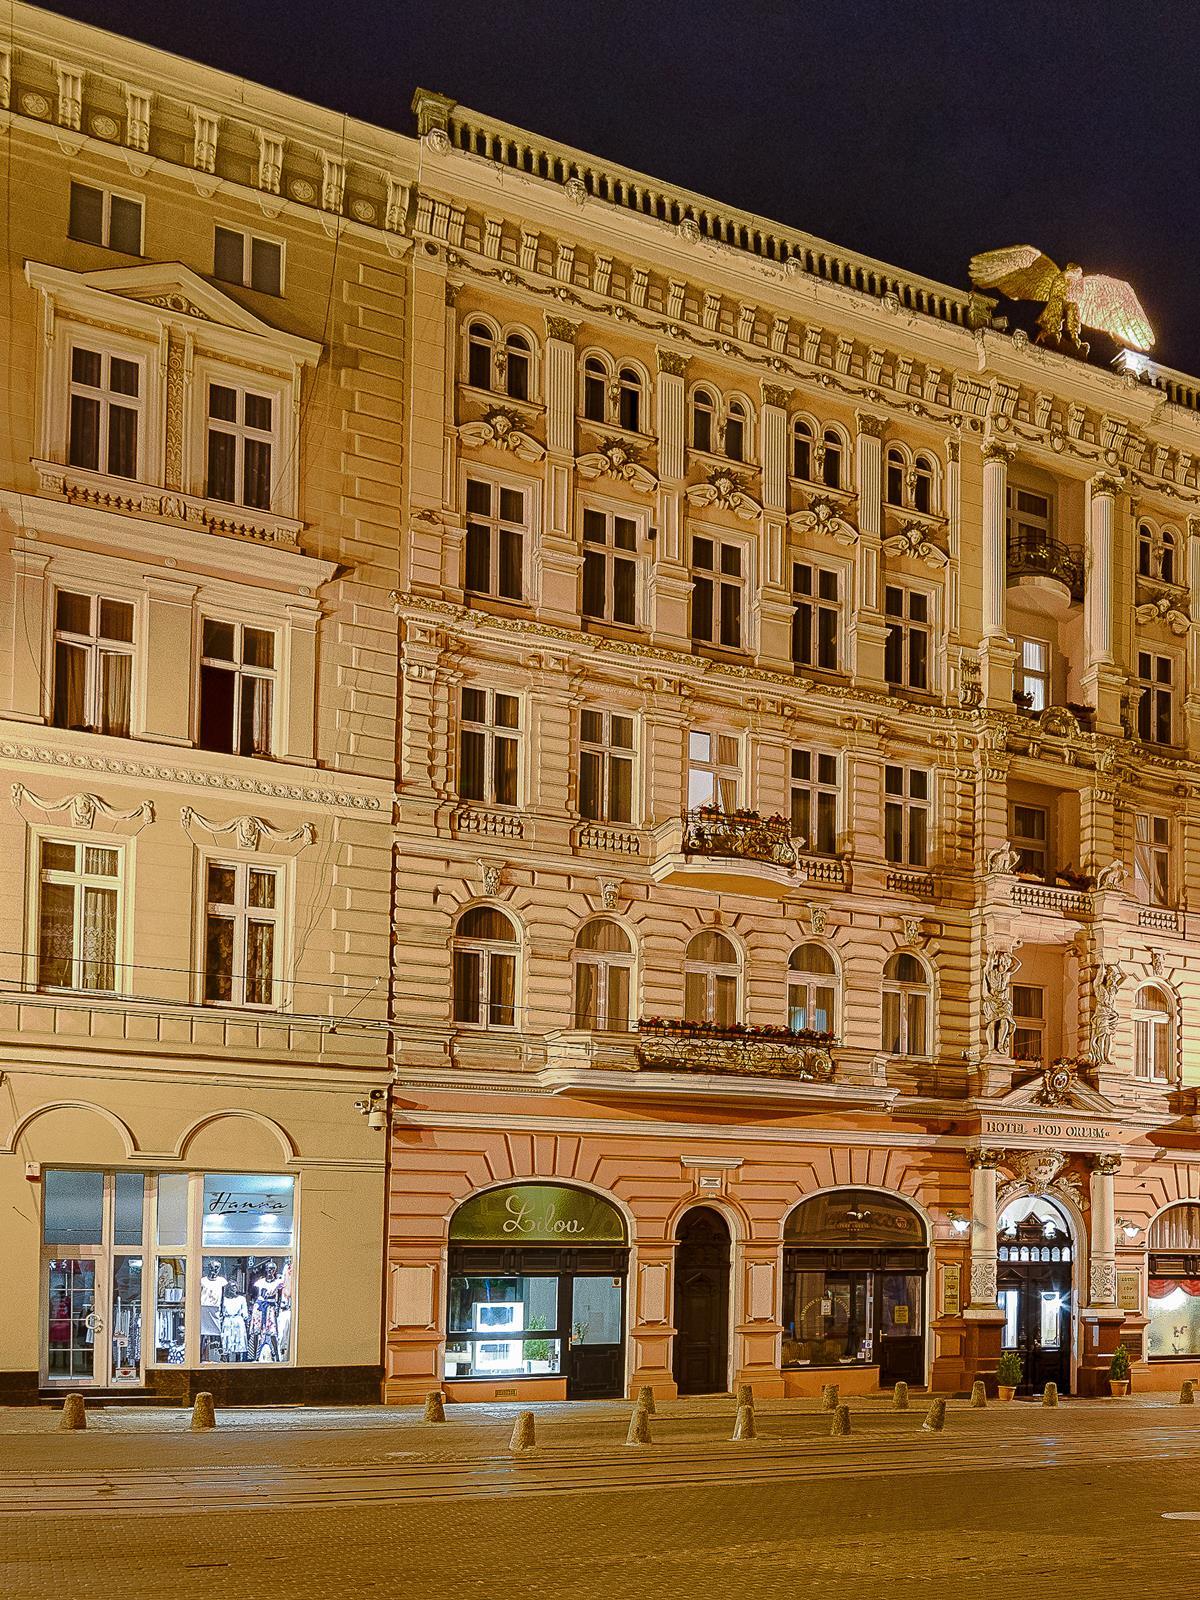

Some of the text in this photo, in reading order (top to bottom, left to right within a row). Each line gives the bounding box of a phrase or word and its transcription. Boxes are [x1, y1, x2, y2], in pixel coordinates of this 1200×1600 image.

[986, 1121, 1028, 1134] HOTEL
[209, 1192, 288, 1211] Hanna
[503, 1195, 584, 1233] Lilou
